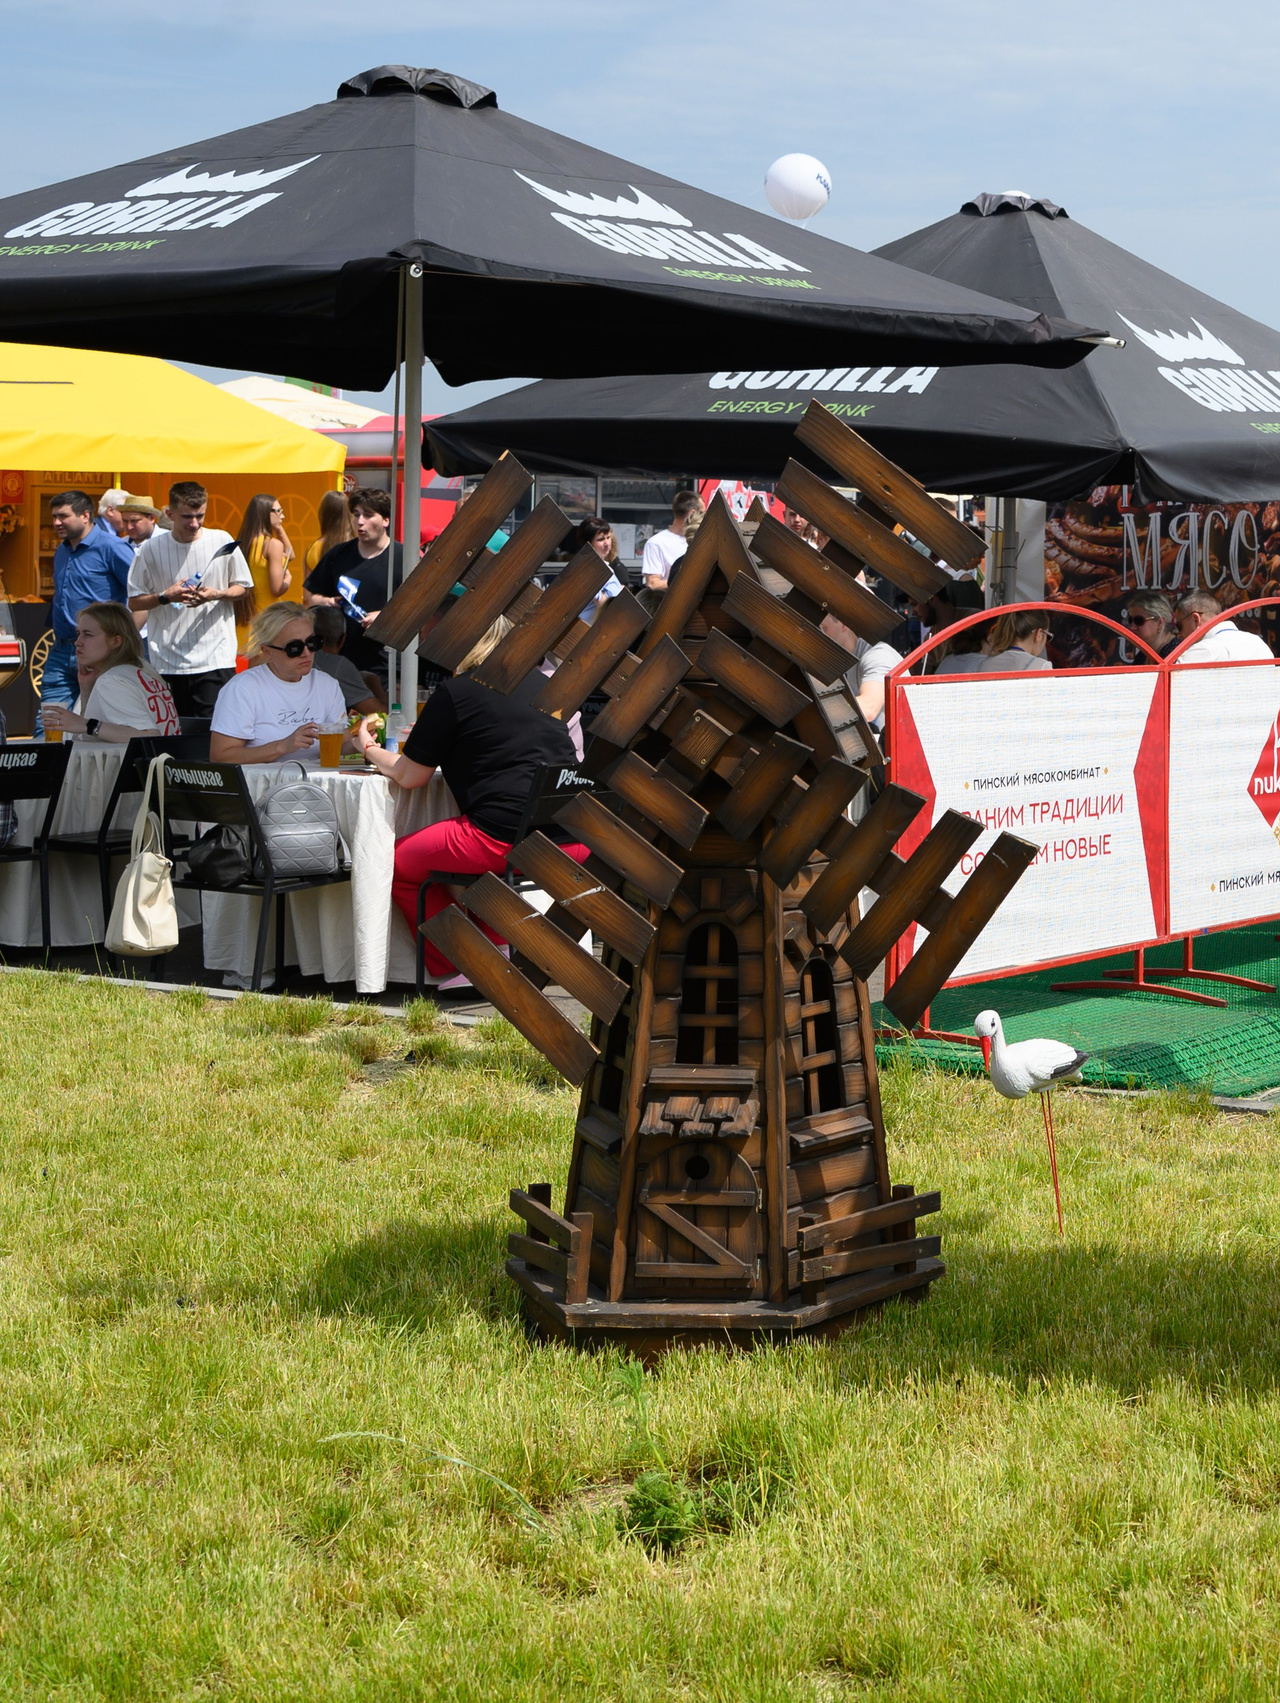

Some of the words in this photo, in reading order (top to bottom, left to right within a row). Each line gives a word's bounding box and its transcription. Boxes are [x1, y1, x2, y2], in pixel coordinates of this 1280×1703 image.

[3, 192, 284, 239] GORILLA
[81, 238, 168, 253] DRINK
[550, 212, 813, 273] GORILLA
[706, 400, 803, 415] ENERGY
[1120, 509, 1260, 591] МЯСО
[973, 773, 1020, 791] ПИНСКИЙ
[1023, 766, 1101, 786] МЯСОКОМБИНАТ
[1029, 793, 1124, 825] ТРАДИЦИИ
[1053, 834, 1112, 862] НОВЫЕ
[1219, 871, 1264, 893] ПИНСКИЙ
